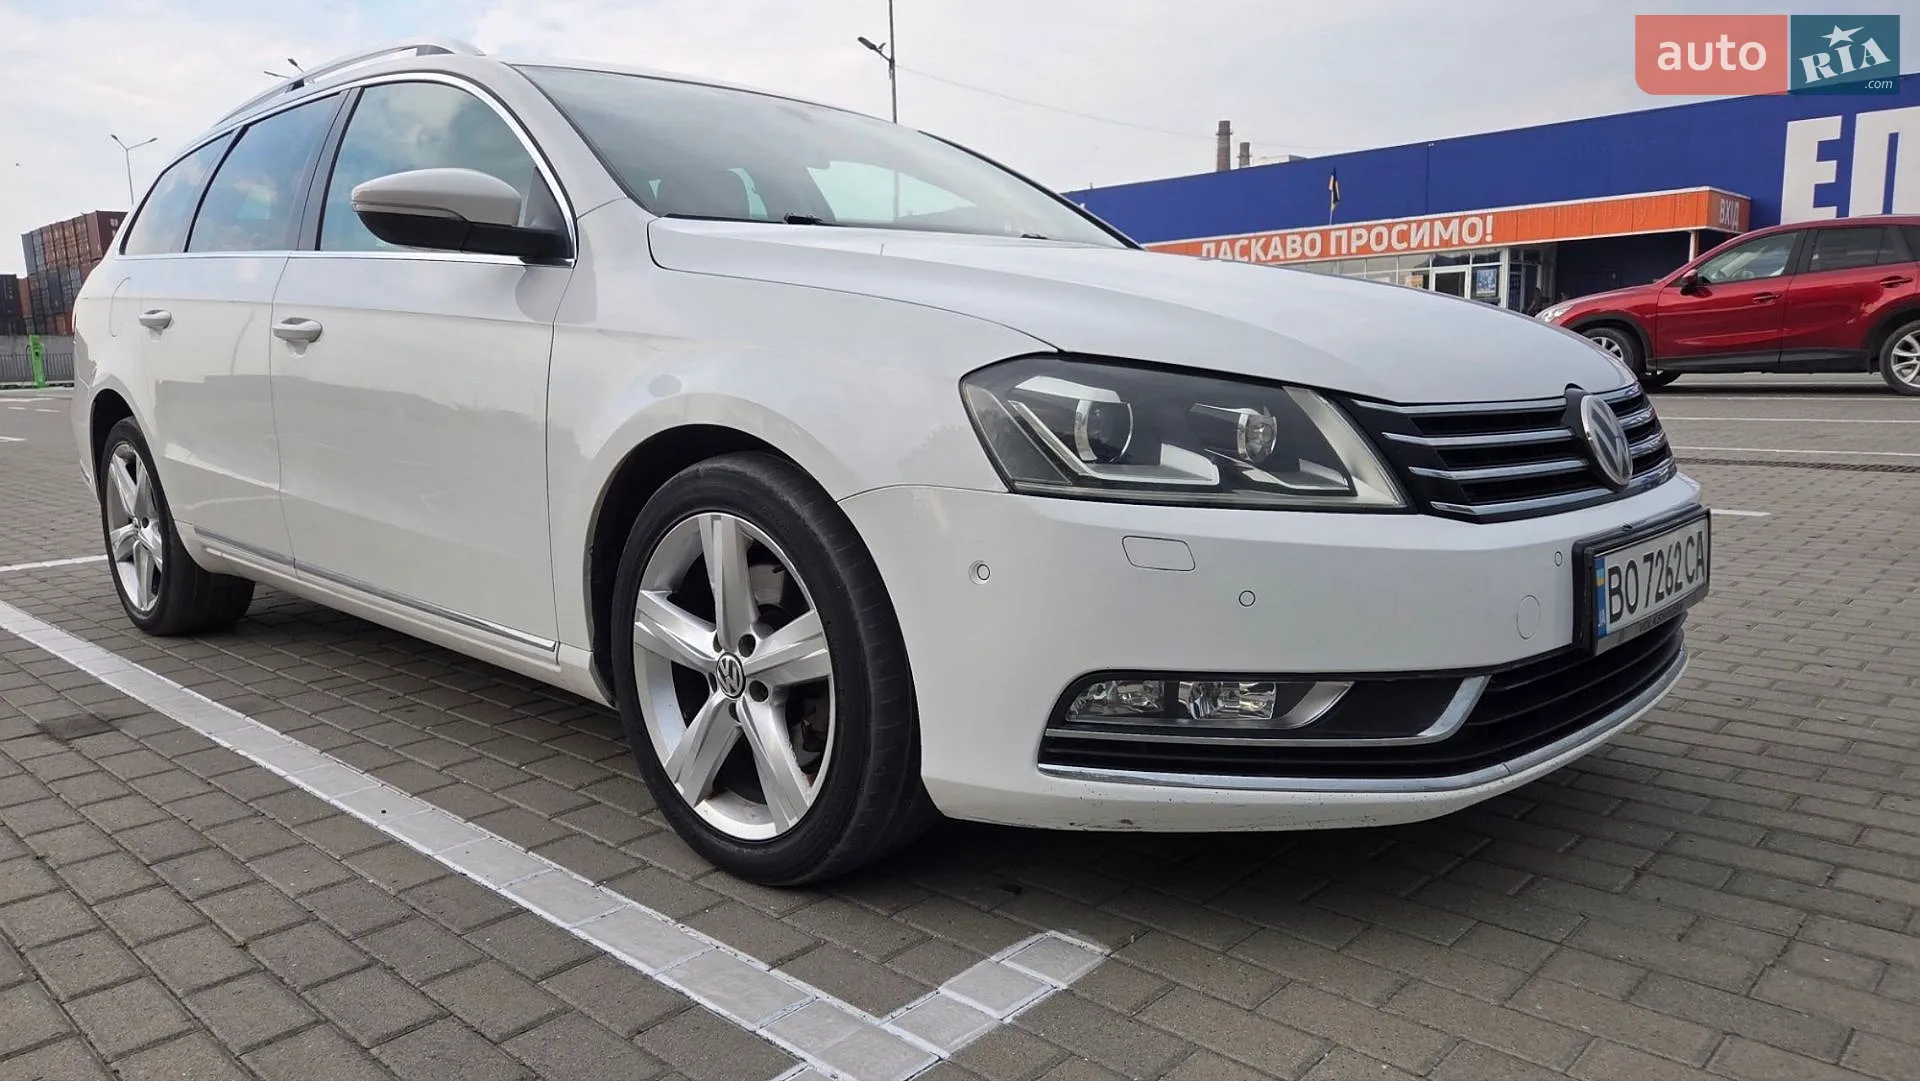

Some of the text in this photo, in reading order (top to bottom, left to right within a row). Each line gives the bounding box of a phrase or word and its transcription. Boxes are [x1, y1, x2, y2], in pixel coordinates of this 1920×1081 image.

[1329, 214, 1495, 255] ПРОСИМО!
[1608, 559, 1639, 624] BO
[1642, 541, 1683, 609] 7262
[1685, 530, 1705, 585] CA
